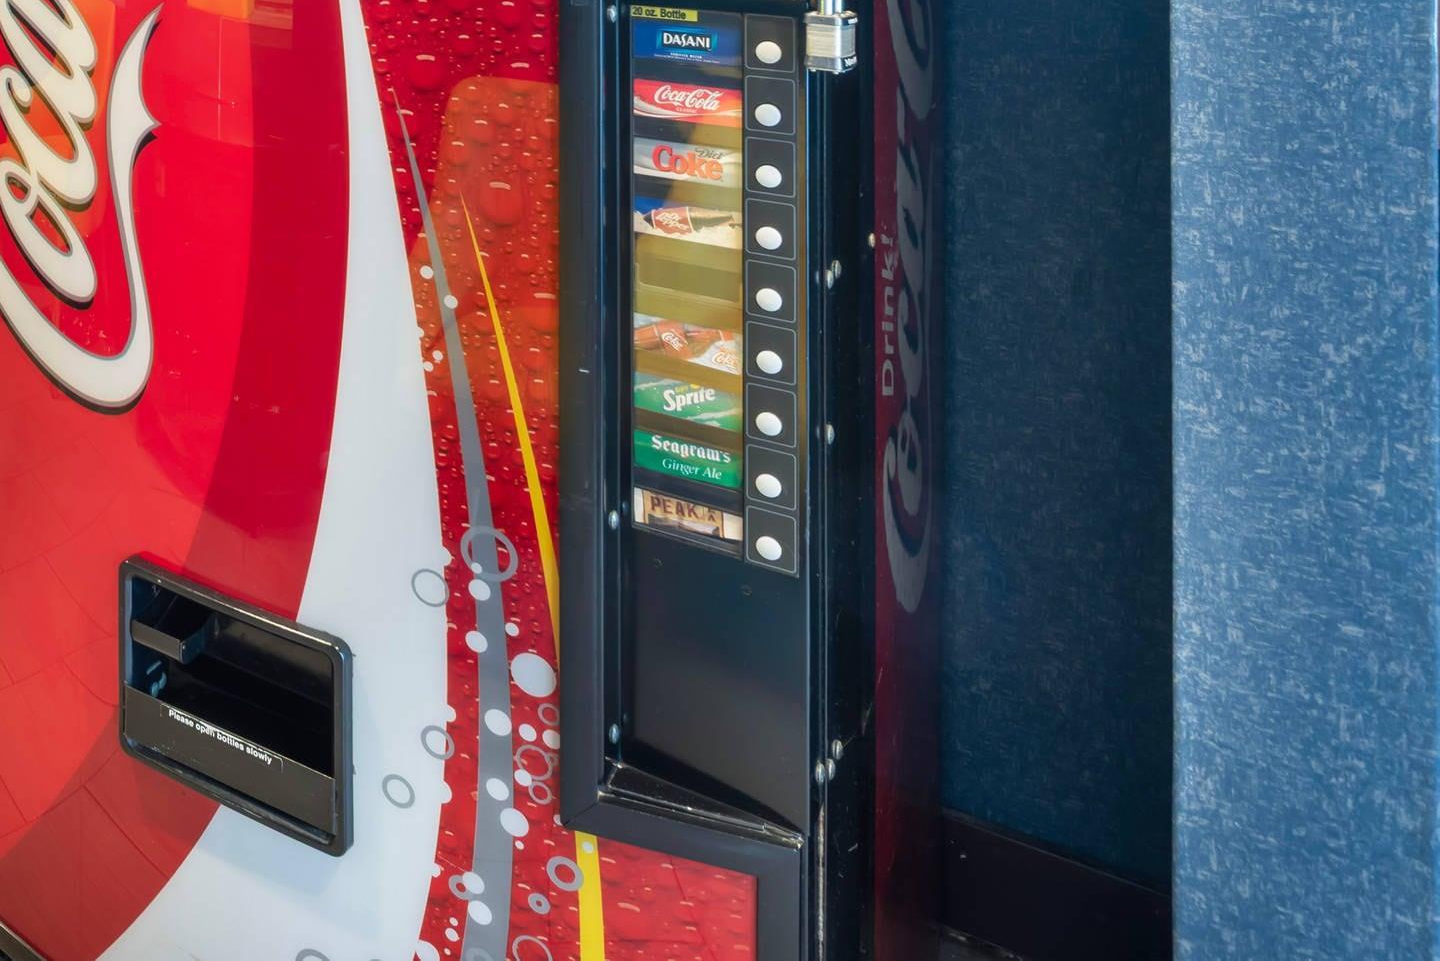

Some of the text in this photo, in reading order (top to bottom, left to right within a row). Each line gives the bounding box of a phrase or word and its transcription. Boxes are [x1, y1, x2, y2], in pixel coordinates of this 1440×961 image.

[632, 6, 688, 20] 20 oz. Bottle
[663, 31, 712, 50] DASANI
[654, 84, 725, 111] Coca-Cola
[651, 143, 724, 181] Coke
[881, 234, 895, 396] Drink!
[663, 386, 716, 412] Sprite
[651, 434, 732, 464] Seagram's
[662, 457, 722, 480] Ginger Ale
[650, 495, 699, 519] PEAK
[168, 708, 273, 765] Please open bottles slowly
